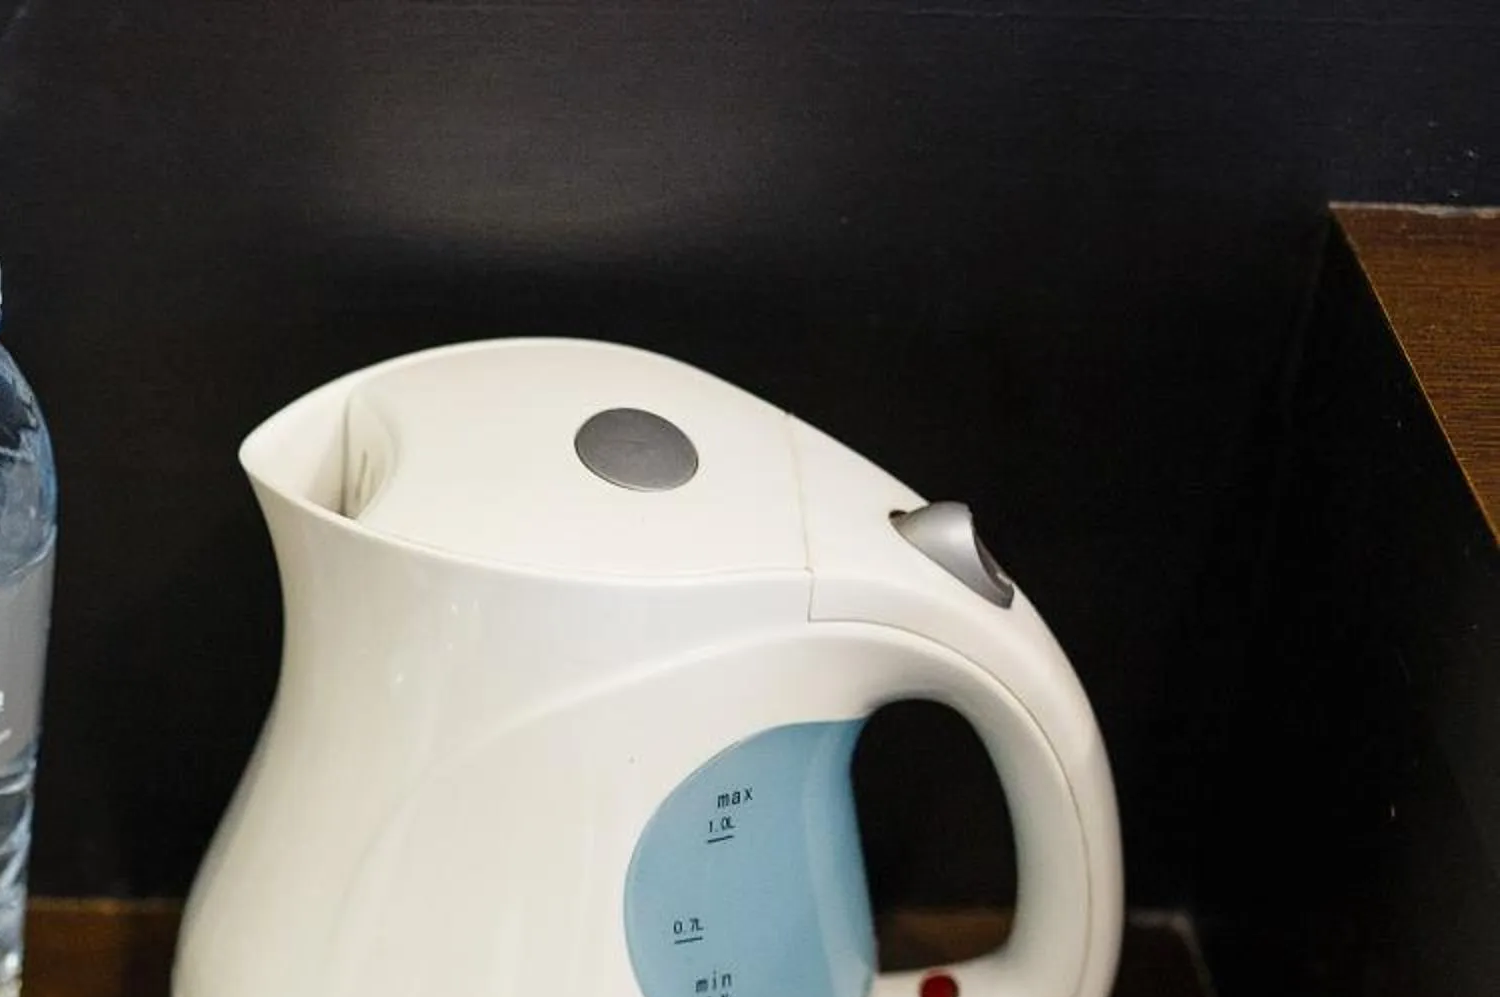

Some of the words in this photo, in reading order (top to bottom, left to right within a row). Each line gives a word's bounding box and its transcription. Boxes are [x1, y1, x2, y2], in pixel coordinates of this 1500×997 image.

[717, 786, 754, 809] max
[673, 917, 704, 935] 0.7L
[695, 971, 733, 994] min
